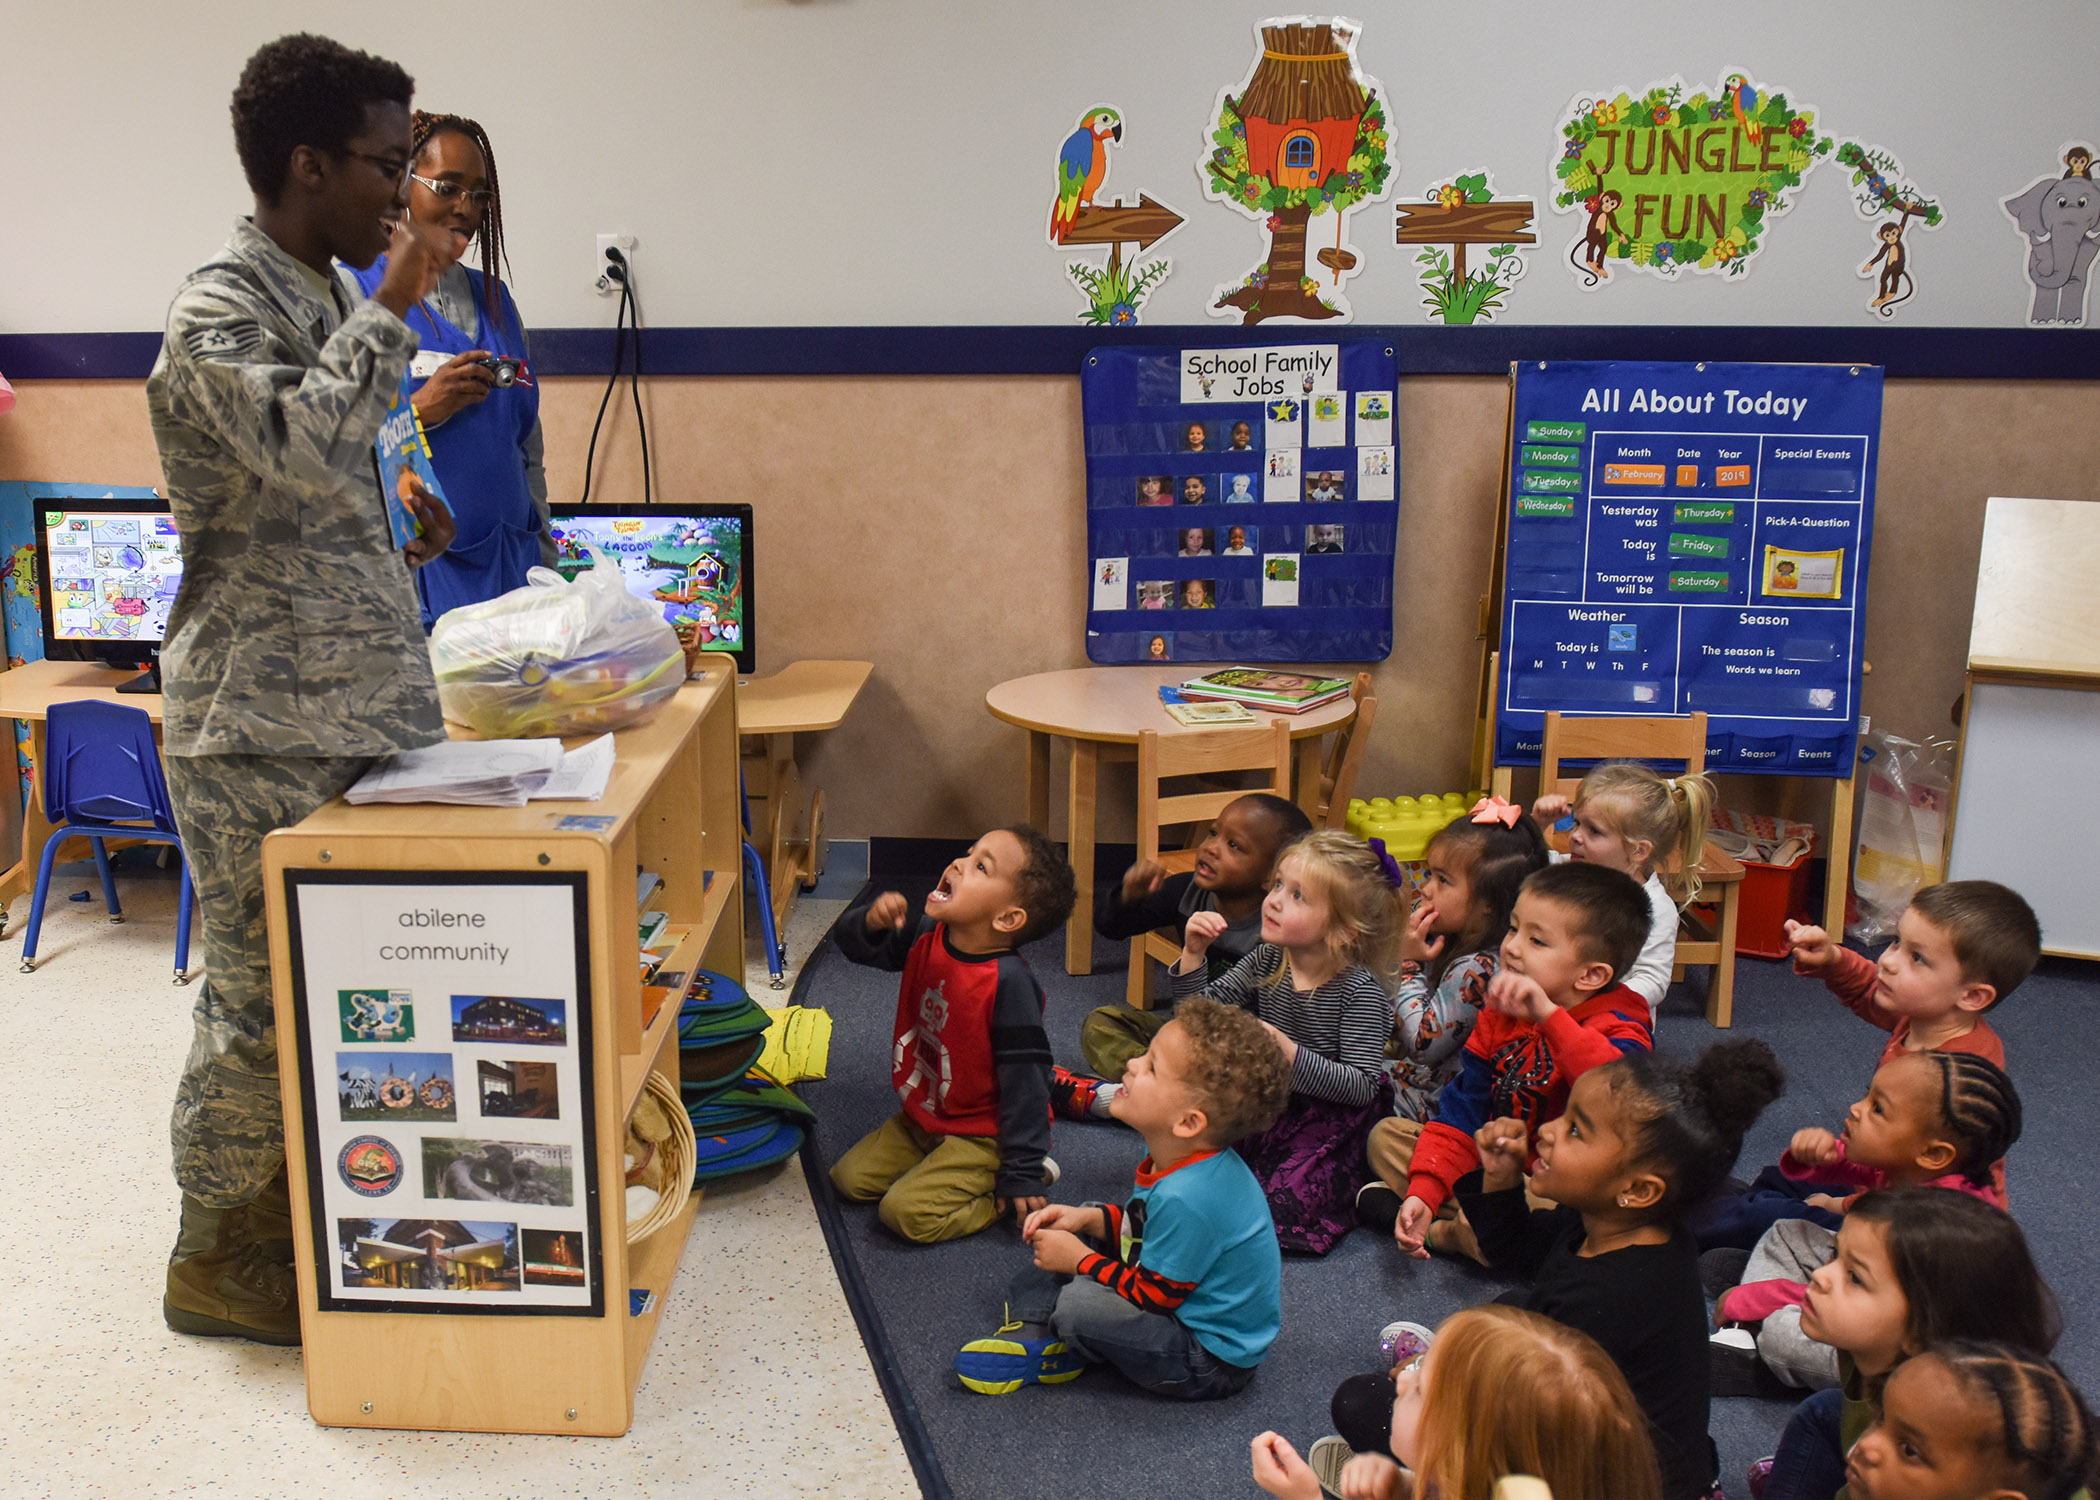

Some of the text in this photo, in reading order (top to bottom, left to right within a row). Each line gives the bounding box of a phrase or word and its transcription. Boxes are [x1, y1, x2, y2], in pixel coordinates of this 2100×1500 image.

[1586, 126, 1786, 175] JUNGLE
[1633, 193, 1727, 239] FUN
[1187, 350, 1333, 377] School Family
[1233, 375, 1285, 397] Jobs
[1581, 387, 1808, 421] All About Today
[1539, 426, 1574, 439] Sunday
[1531, 451, 1569, 463] Monday
[1617, 447, 1743, 459] Month Date Year
[1774, 448, 1851, 460] Special Events
[1532, 475, 1572, 488] Tuesday
[1622, 469, 1663, 481] February
[1684, 471, 1689, 481] 1
[1720, 470, 1745, 482] 2019
[1523, 500, 1567, 513] Wednesday
[1601, 505, 1659, 519] Yesterday
[1683, 508, 1726, 520] Thursday
[1635, 518, 1658, 527] was
[1765, 515, 1851, 528] Pick-A-Question
[604, 540, 653, 552] LAGOON
[1622, 539, 1657, 552] Today
[1683, 539, 1715, 553] Friday
[1646, 550, 1656, 561] is
[1596, 572, 1655, 583] Tomorrow
[1677, 577, 1721, 589] Saturday
[1615, 584, 1654, 595] will be
[1568, 608, 1627, 622] Weather
[1739, 612, 1790, 626] Season
[1555, 641, 1599, 655] Today is
[1701, 645, 1776, 657] The season is
[1533, 660, 1649, 671] M T W Th F
[1725, 664, 1801, 676] Words we learn
[1516, 742, 1543, 751] Mont
[1739, 747, 1777, 759] Season
[1797, 749, 1833, 759] Events
[398, 908, 486, 928] abilene
[379, 941, 509, 966] community
